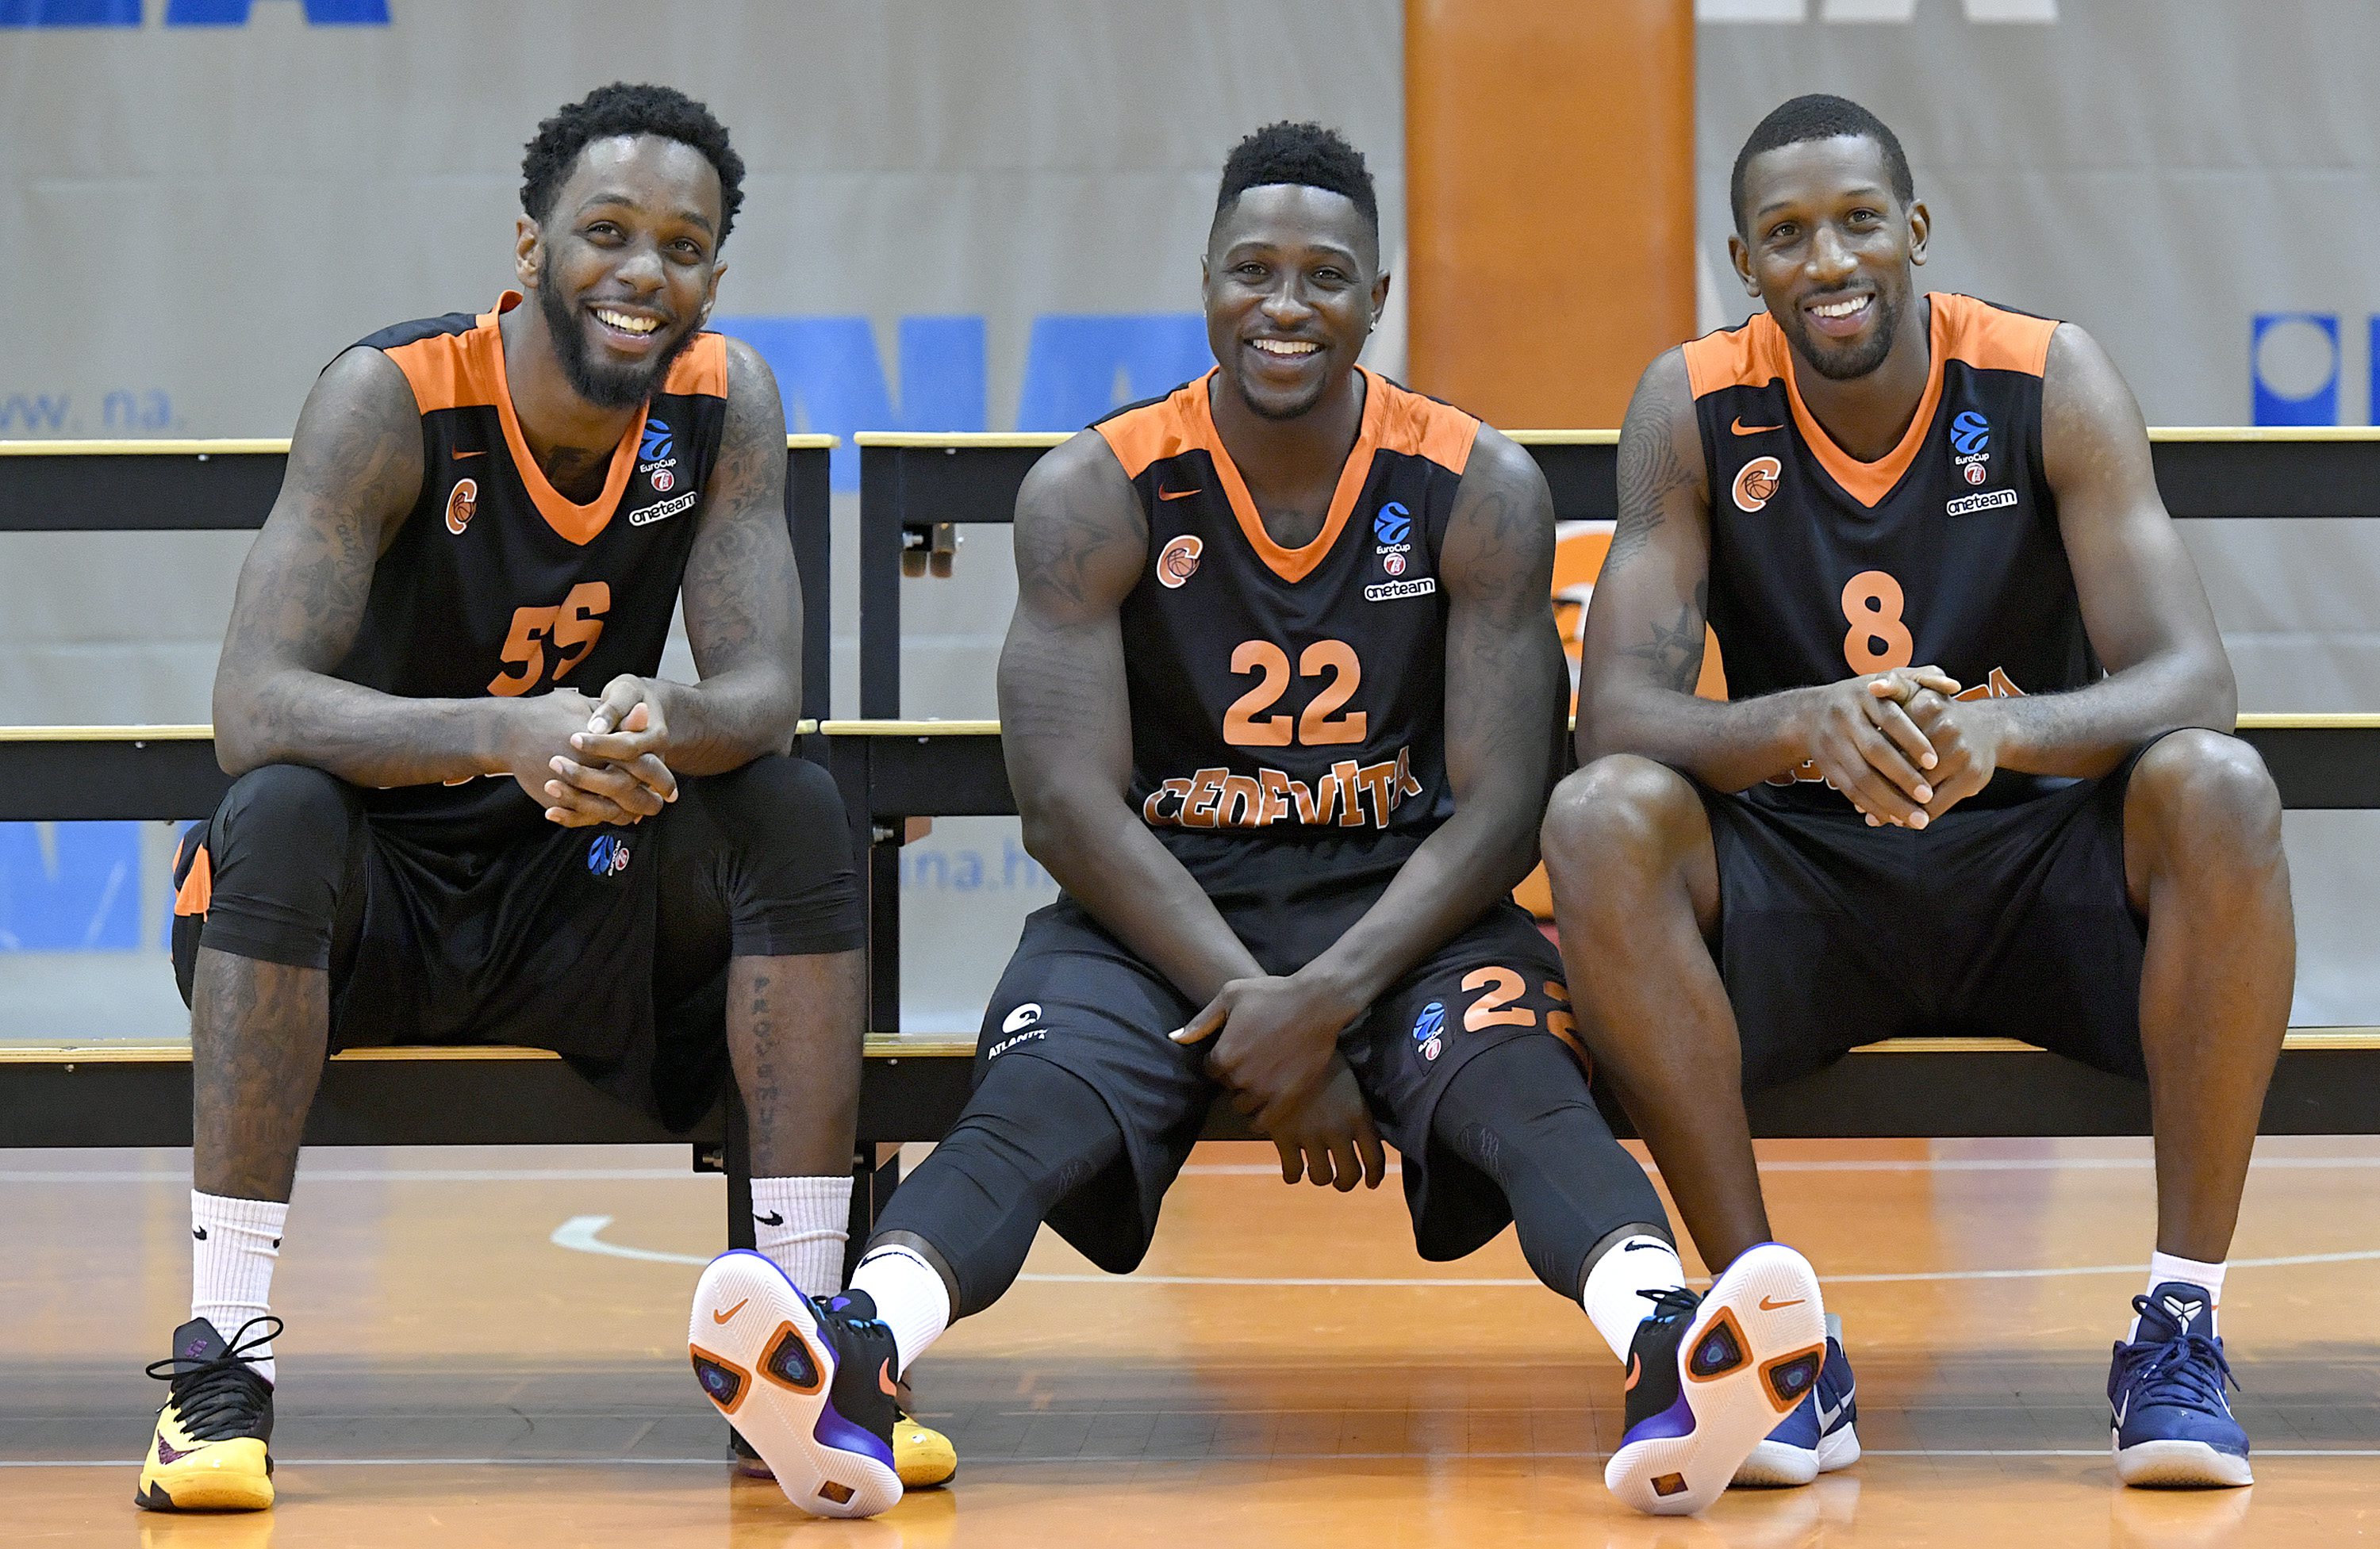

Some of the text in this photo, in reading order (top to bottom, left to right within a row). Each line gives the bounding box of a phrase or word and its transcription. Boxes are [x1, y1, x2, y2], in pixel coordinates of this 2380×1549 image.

[639, 458, 677, 474] EuroCup
[1955, 452, 1990, 466] EuroCup
[631, 493, 697, 523] oneteam
[1948, 491, 2015, 514] oneteam
[1376, 543, 1411, 554] EuroCup
[1366, 579, 1434, 599] oneteam
[1841, 570, 1914, 676] 8
[1223, 639, 1367, 746] 22
[1143, 745, 1422, 830] CEDEVITA
